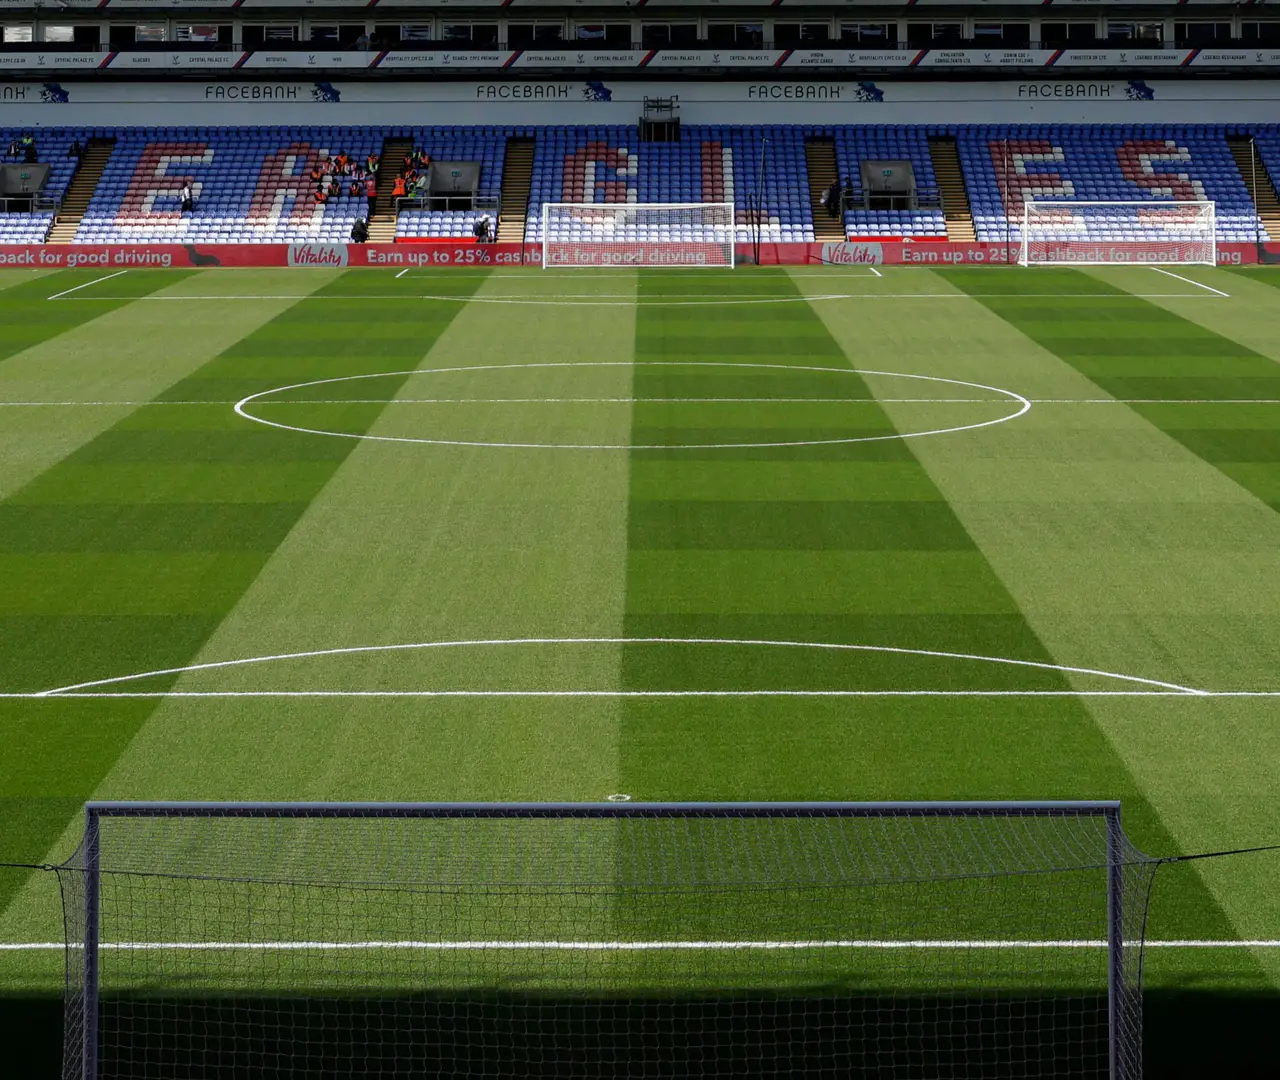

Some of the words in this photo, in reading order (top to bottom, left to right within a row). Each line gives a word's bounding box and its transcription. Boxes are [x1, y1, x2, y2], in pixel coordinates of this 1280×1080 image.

[205, 86, 297, 99] FACEBANK
[477, 85, 568, 98] FACEBANK
[748, 85, 840, 99] FACEBANK
[1018, 84, 1111, 98] FACEBANK
[39, 250, 62, 264] for
[66, 250, 109, 267] good
[114, 250, 172, 267] driving
[293, 244, 343, 267] Vitality
[367, 250, 402, 263] Earn
[408, 252, 429, 267] up
[433, 252, 449, 264] to
[454, 249, 491, 264] 25%
[827, 244, 877, 265] Vitality
[902, 249, 936, 262] Earn
[943, 251, 963, 265] up
[967, 249, 984, 261] to
[1030, 247, 1103, 262] cashback
[1108, 248, 1132, 262] for
[1136, 248, 1179, 264] good
